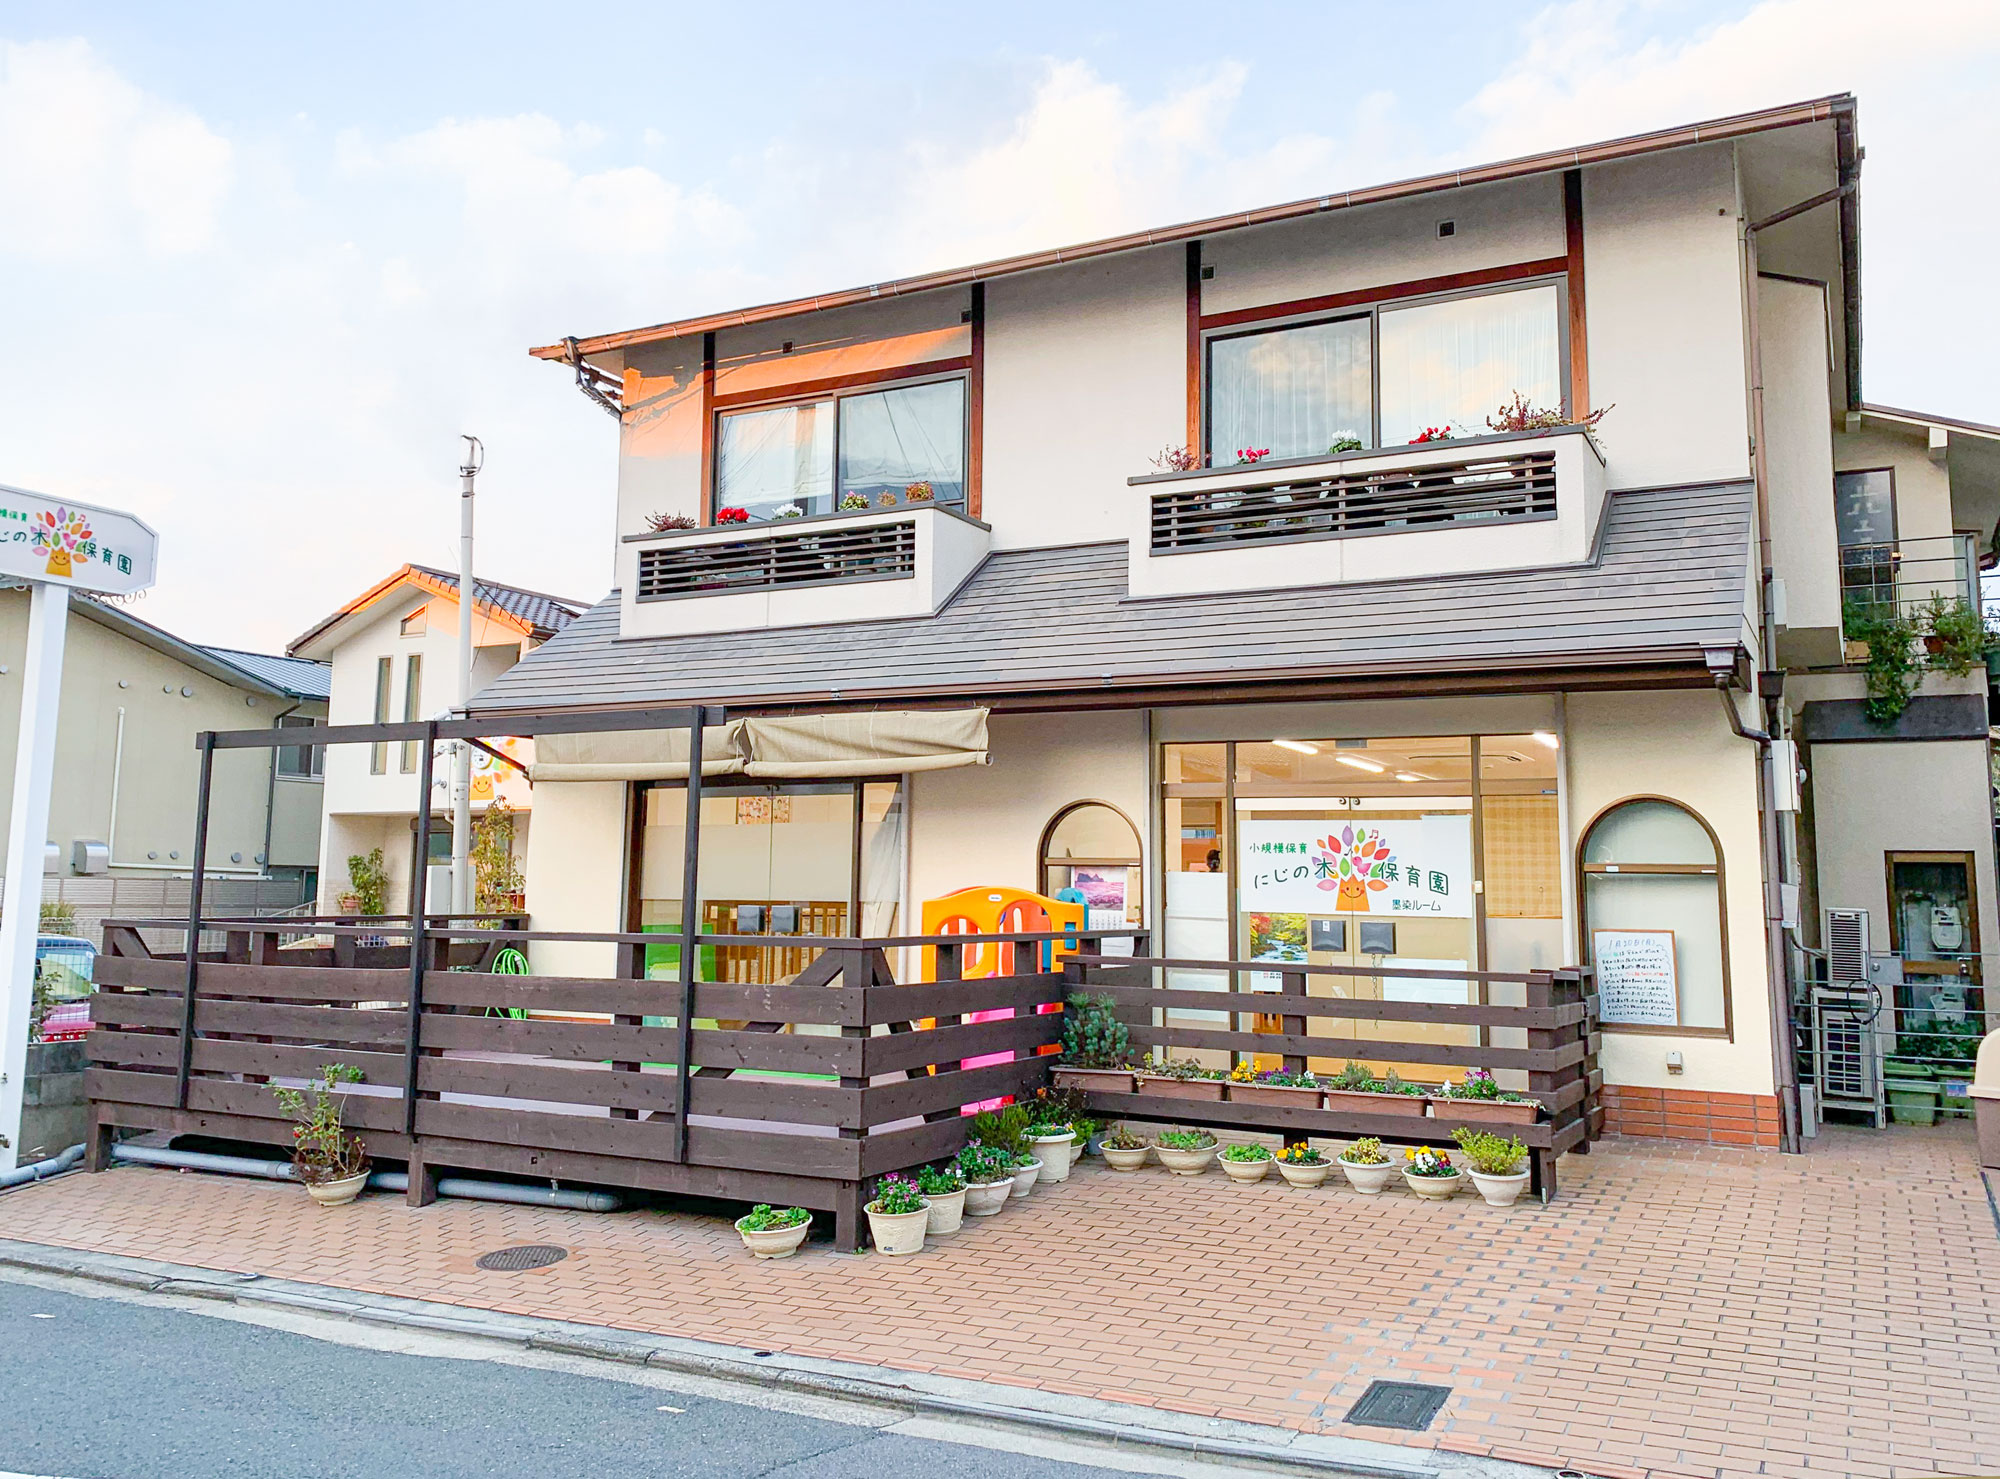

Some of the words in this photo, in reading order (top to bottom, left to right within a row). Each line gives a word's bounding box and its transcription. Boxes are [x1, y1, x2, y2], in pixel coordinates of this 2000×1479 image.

[1249, 842, 1307, 855] 小規模保育
